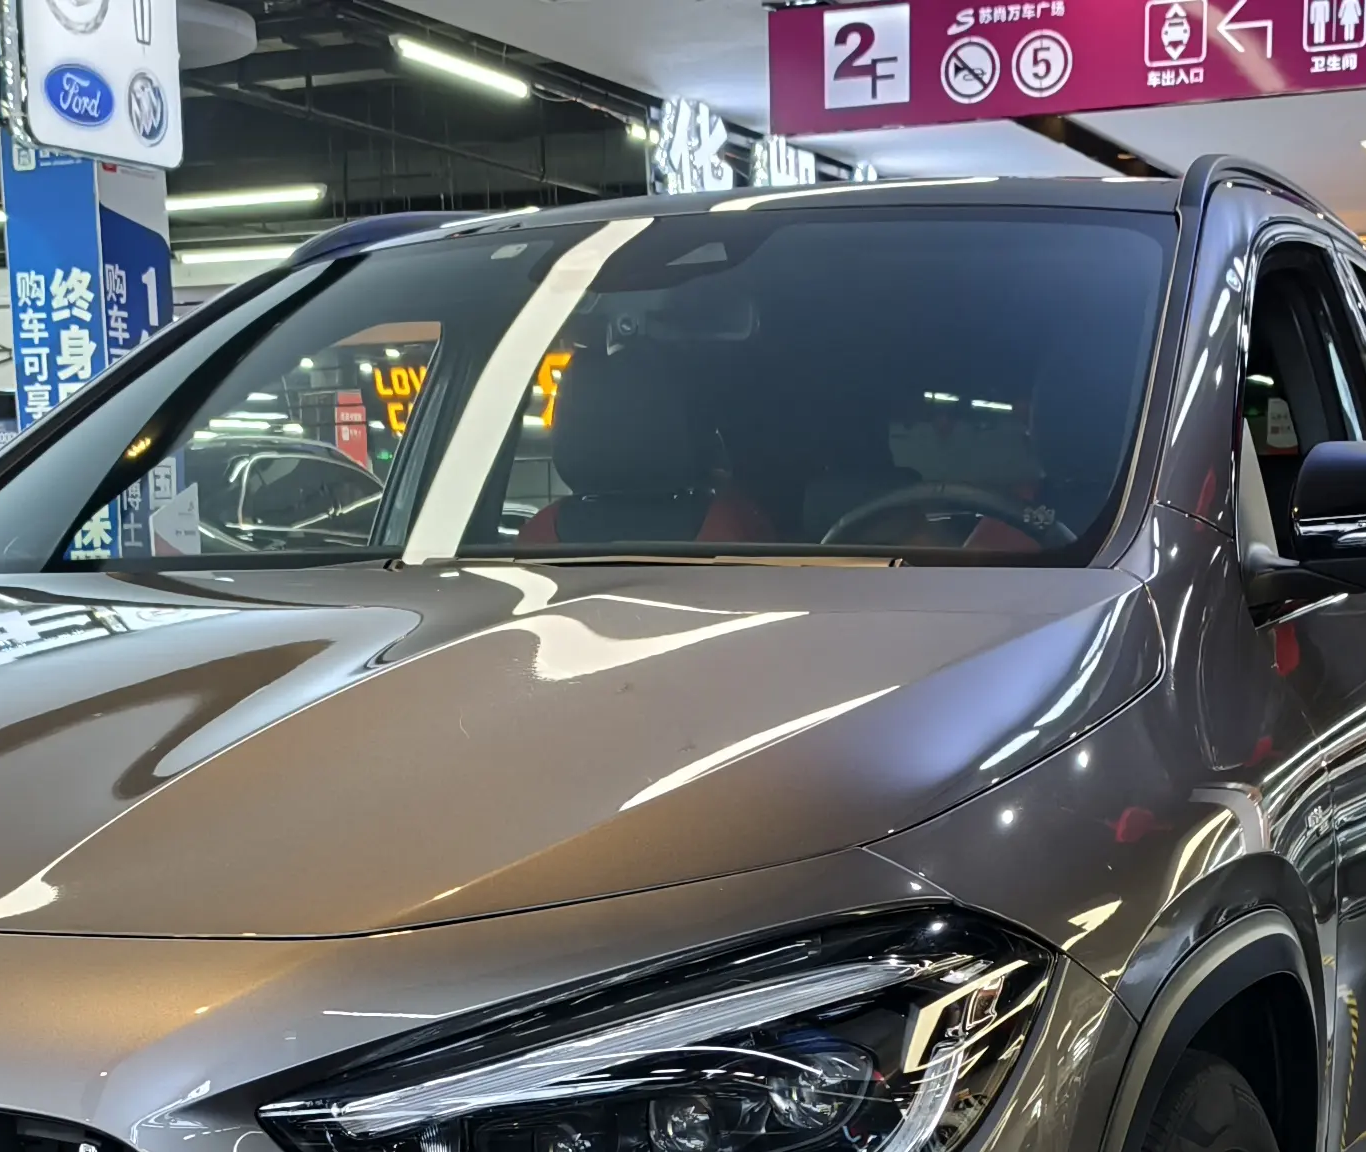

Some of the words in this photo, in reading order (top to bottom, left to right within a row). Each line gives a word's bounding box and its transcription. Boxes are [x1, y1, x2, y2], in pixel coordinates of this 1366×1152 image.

[1031, 47, 1051, 80] 5
[1146, 67, 1204, 88] 车出入口
[1310, 52, 1358, 73] 卫生间
[59, 72, 103, 118] Ford
[104, 263, 131, 366] 购车
